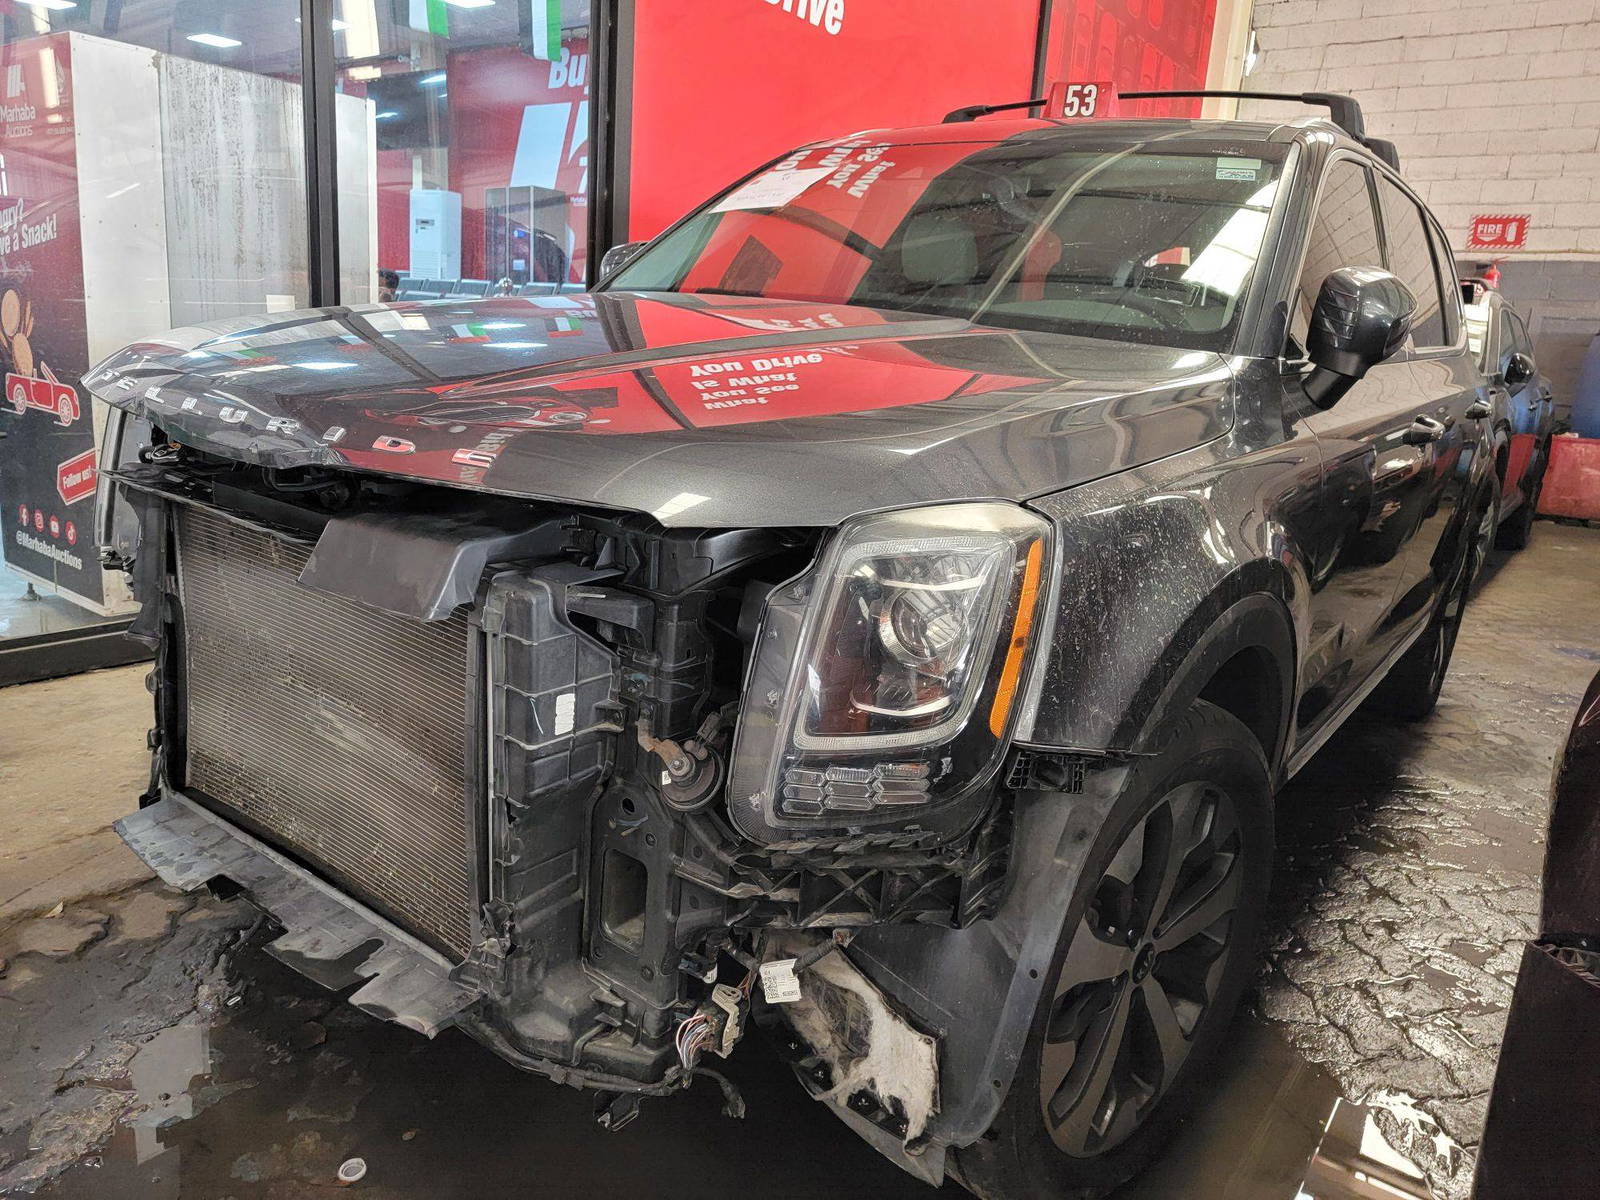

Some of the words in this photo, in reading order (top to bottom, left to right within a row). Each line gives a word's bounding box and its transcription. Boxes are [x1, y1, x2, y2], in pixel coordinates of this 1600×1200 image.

[548, 47, 589, 95] Bu
[0, 104, 36, 122] Marhaba
[1064, 84, 1098, 117] 53
[13, 232, 19, 252] a
[22, 213, 57, 249] Snack!
[1477, 223, 1503, 235] FIRE
[16, 530, 83, 570] @MarhabaAuctions
